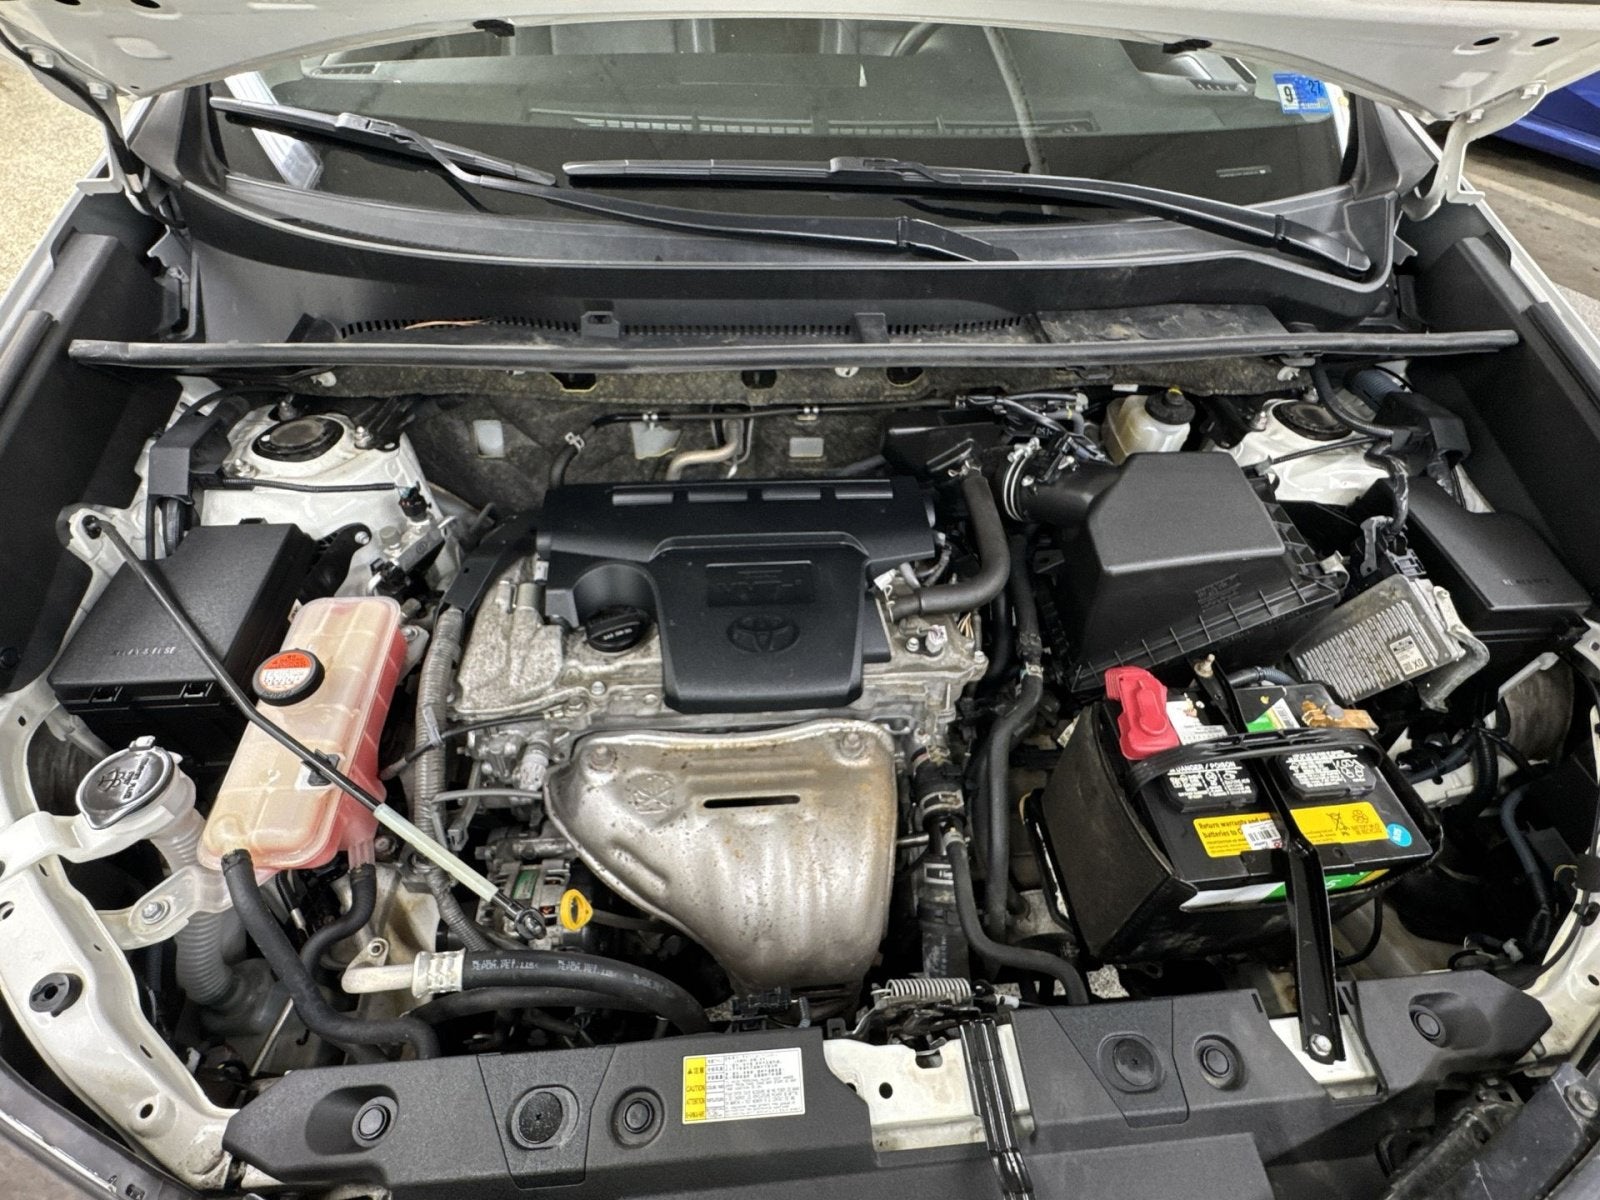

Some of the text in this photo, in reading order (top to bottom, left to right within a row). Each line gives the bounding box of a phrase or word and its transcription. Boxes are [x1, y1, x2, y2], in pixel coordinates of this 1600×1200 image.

[1308, 80, 1322, 96] 27
[1283, 86, 1294, 103] 9
[1209, 761, 1237, 769] POISON
[1220, 820, 1247, 828] warranty
[1202, 830, 1230, 839] batteries
